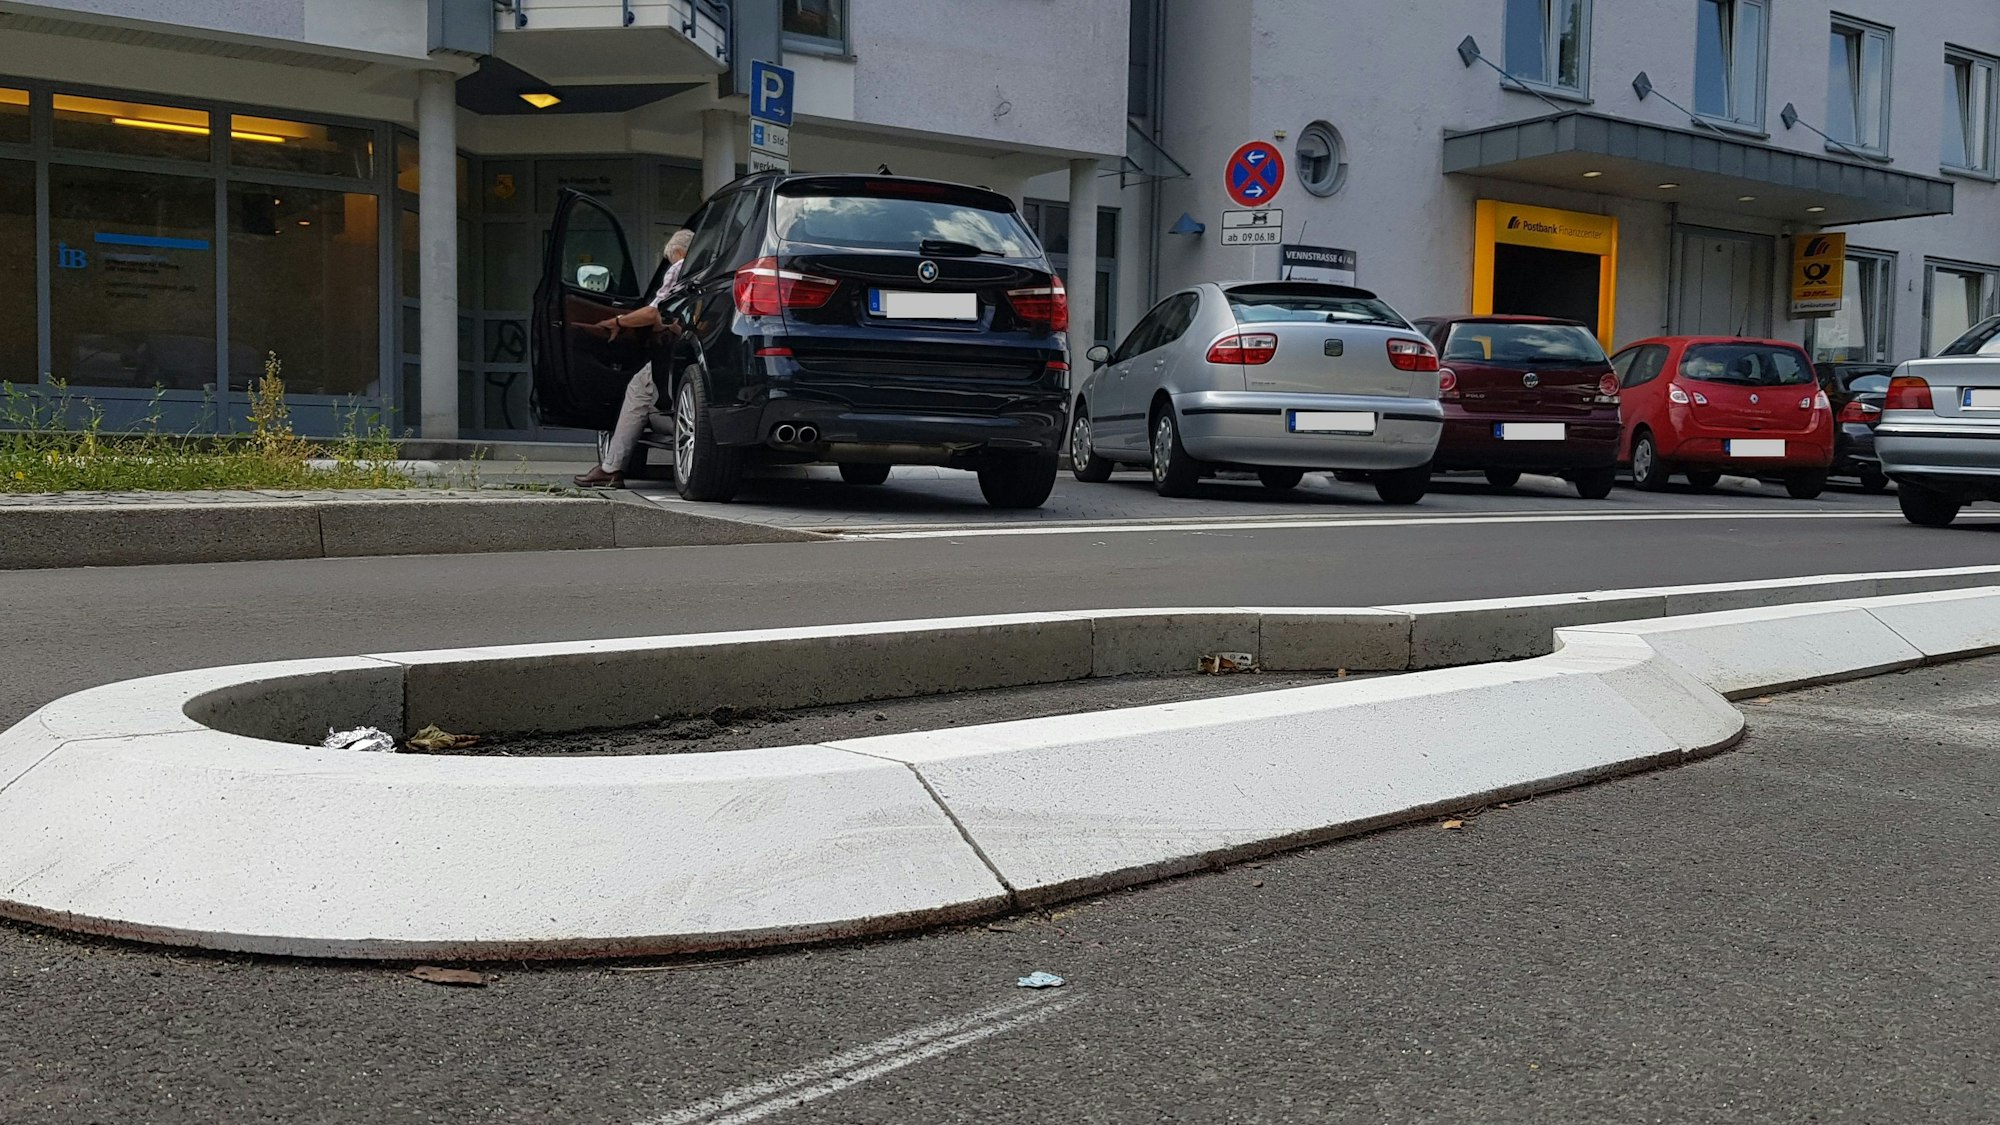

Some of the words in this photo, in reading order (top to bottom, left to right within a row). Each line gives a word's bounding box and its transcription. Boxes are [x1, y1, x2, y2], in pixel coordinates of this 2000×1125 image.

[760, 69, 784, 113] P
[1228, 234, 1238, 242] ab
[1242, 233, 1275, 242] 09.06.18
[1523, 220, 1557, 234] Postbank
[1559, 225, 1602, 239] Finanzcenter
[1286, 250, 1338, 263] VENNSTRASSE
